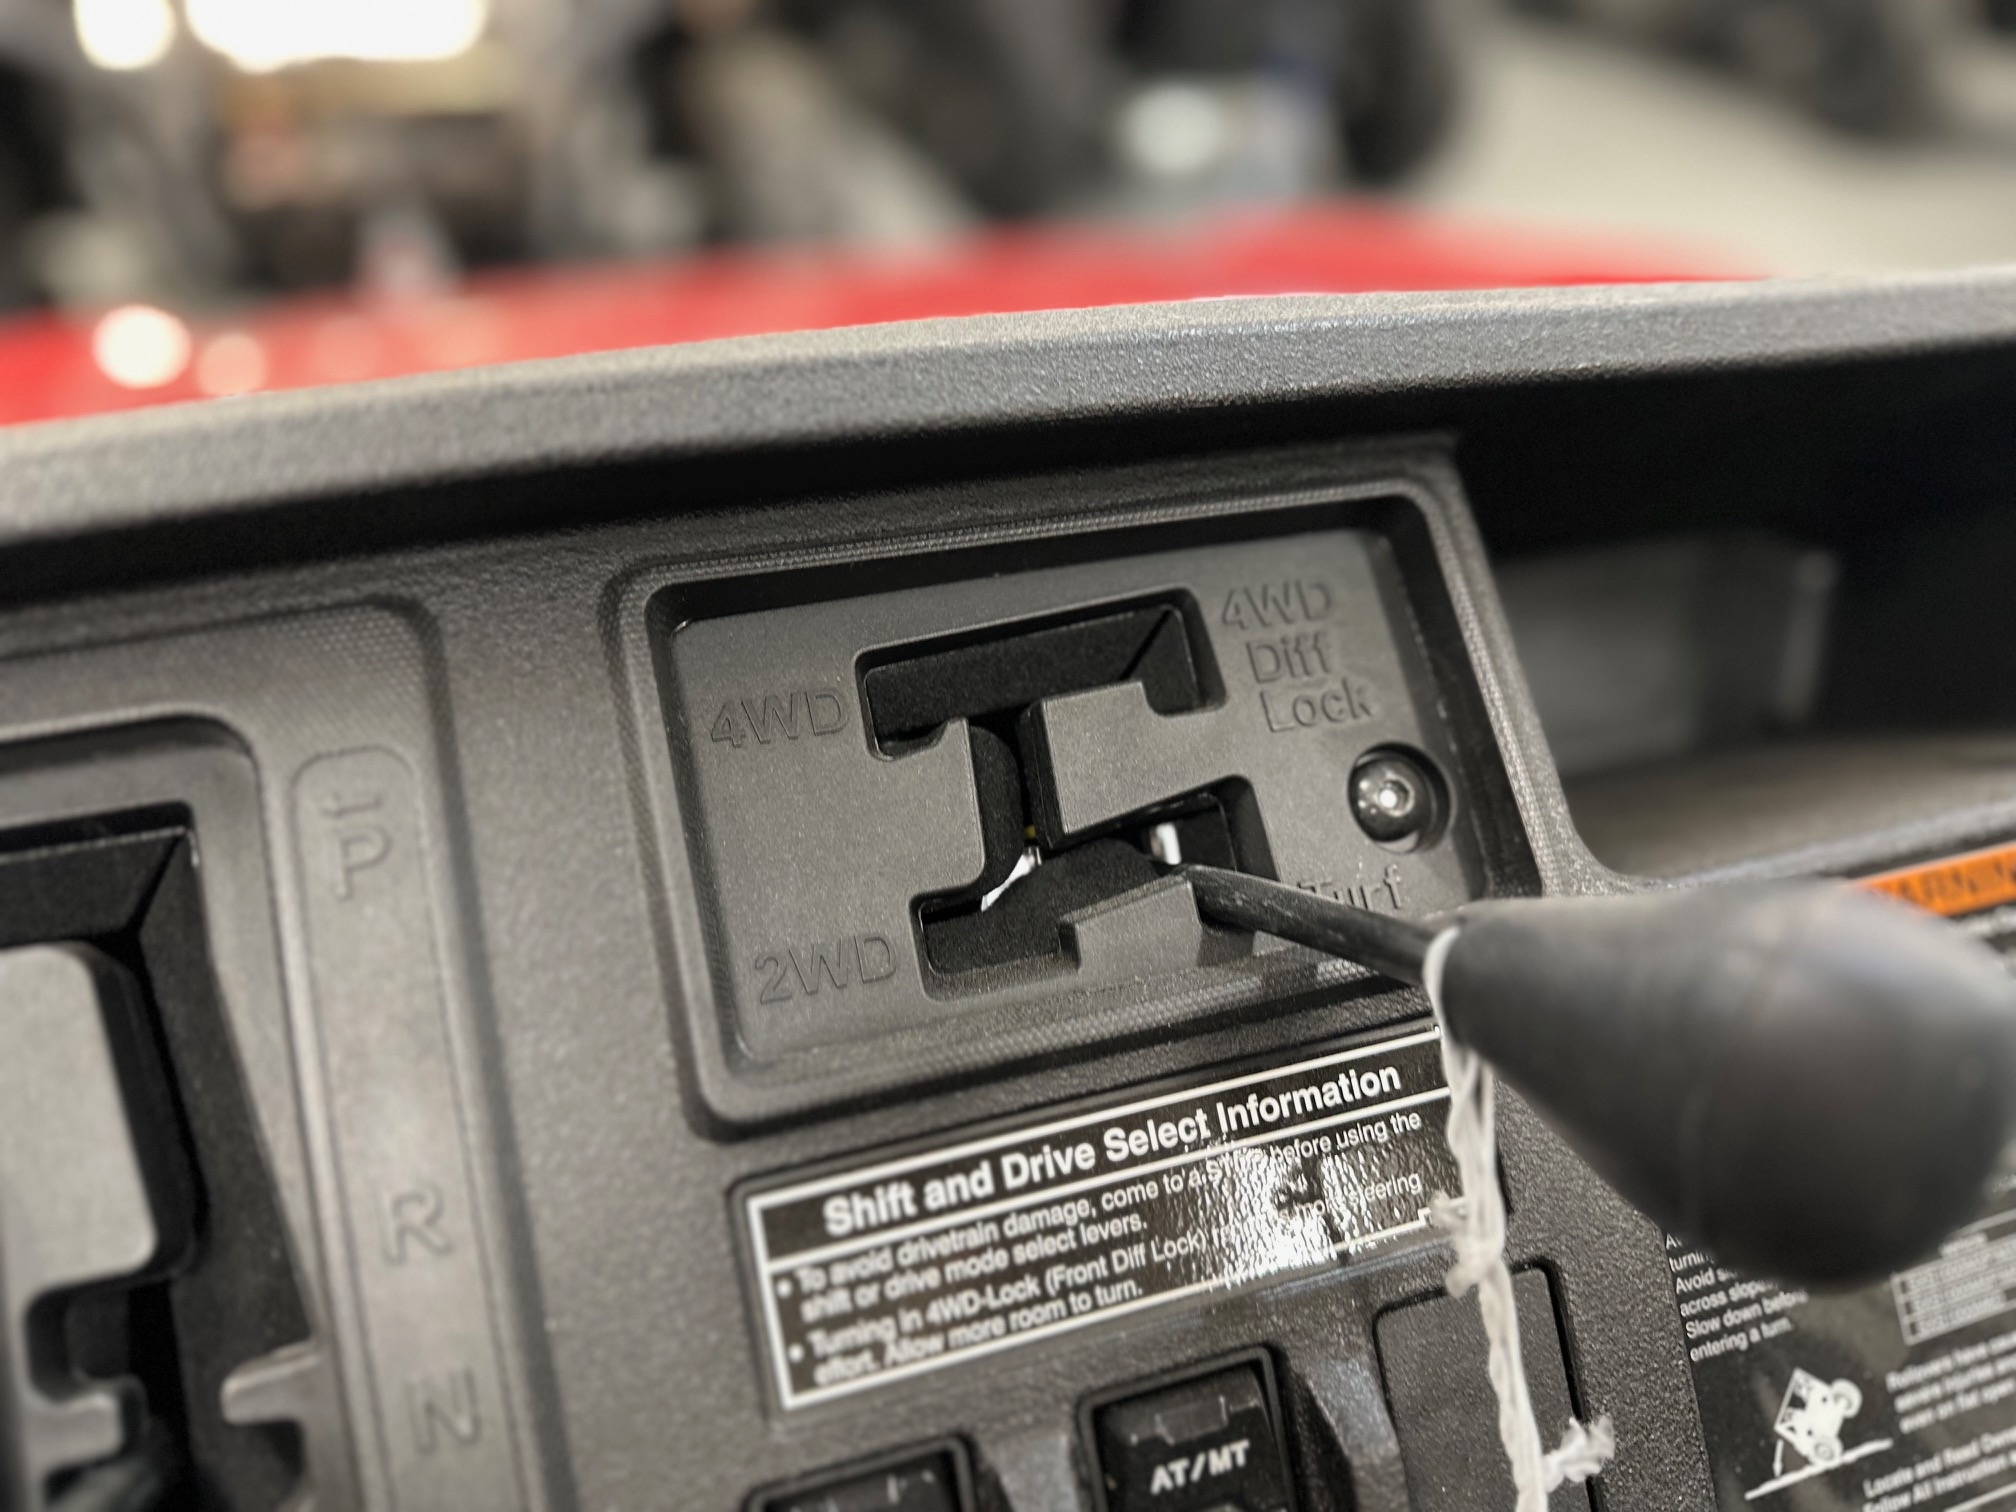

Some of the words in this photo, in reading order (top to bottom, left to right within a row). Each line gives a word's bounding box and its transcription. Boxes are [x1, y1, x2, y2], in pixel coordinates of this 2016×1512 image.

[1222, 578, 1333, 631] 4WD
[1247, 631, 1333, 685] Diff
[709, 690, 851, 752] 4WD
[1260, 679, 1371, 732] Lock
[332, 824, 392, 901] P
[754, 934, 899, 1007] 2WD
[823, 1180, 918, 1237] Shift
[923, 1160, 995, 1211] and
[1002, 1141, 1096, 1191] Drive
[1103, 1107, 1212, 1163] Select
[1216, 1065, 1400, 1133] Information
[386, 1186, 452, 1266] R
[795, 1266, 828, 1293] To
[828, 1245, 893, 1284] avoid
[896, 1221, 1001, 1267] drivetrain
[1002, 1196, 1099, 1238] damage,
[1101, 1180, 1159, 1212] come
[1162, 1173, 1185, 1195] to
[1336, 1120, 1388, 1149] using
[1390, 1111, 1423, 1135] the
[801, 1287, 852, 1323] shift
[854, 1282, 882, 1308] or
[883, 1267, 942, 1300] drive
[944, 1248, 1010, 1284] mode
[1012, 1228, 1078, 1265] select
[1080, 1211, 1148, 1247] levers.
[806, 1316, 898, 1356] Turning
[898, 1307, 924, 1333] in
[925, 1273, 1041, 1325] 4WD-Lock
[1044, 1254, 1110, 1295] (Front
[1111, 1242, 1147, 1275] Diff
[1151, 1226, 1208, 1263] Lock)
[1676, 1267, 1715, 1294] Avoid
[813, 1347, 880, 1386] effort.
[883, 1331, 946, 1368] Allow
[947, 1313, 1007, 1348] more
[1008, 1295, 1068, 1331] room
[1068, 1289, 1093, 1312] to
[1093, 1278, 1144, 1308] turn.
[1680, 1291, 1727, 1317] across
[1686, 1316, 1721, 1339] Slow
[1723, 1303, 1762, 1327] down
[1690, 1333, 1748, 1361] entering
[1750, 1327, 1761, 1343] a
[408, 1366, 483, 1456] N
[1150, 1437, 1251, 1496] AT/MT
